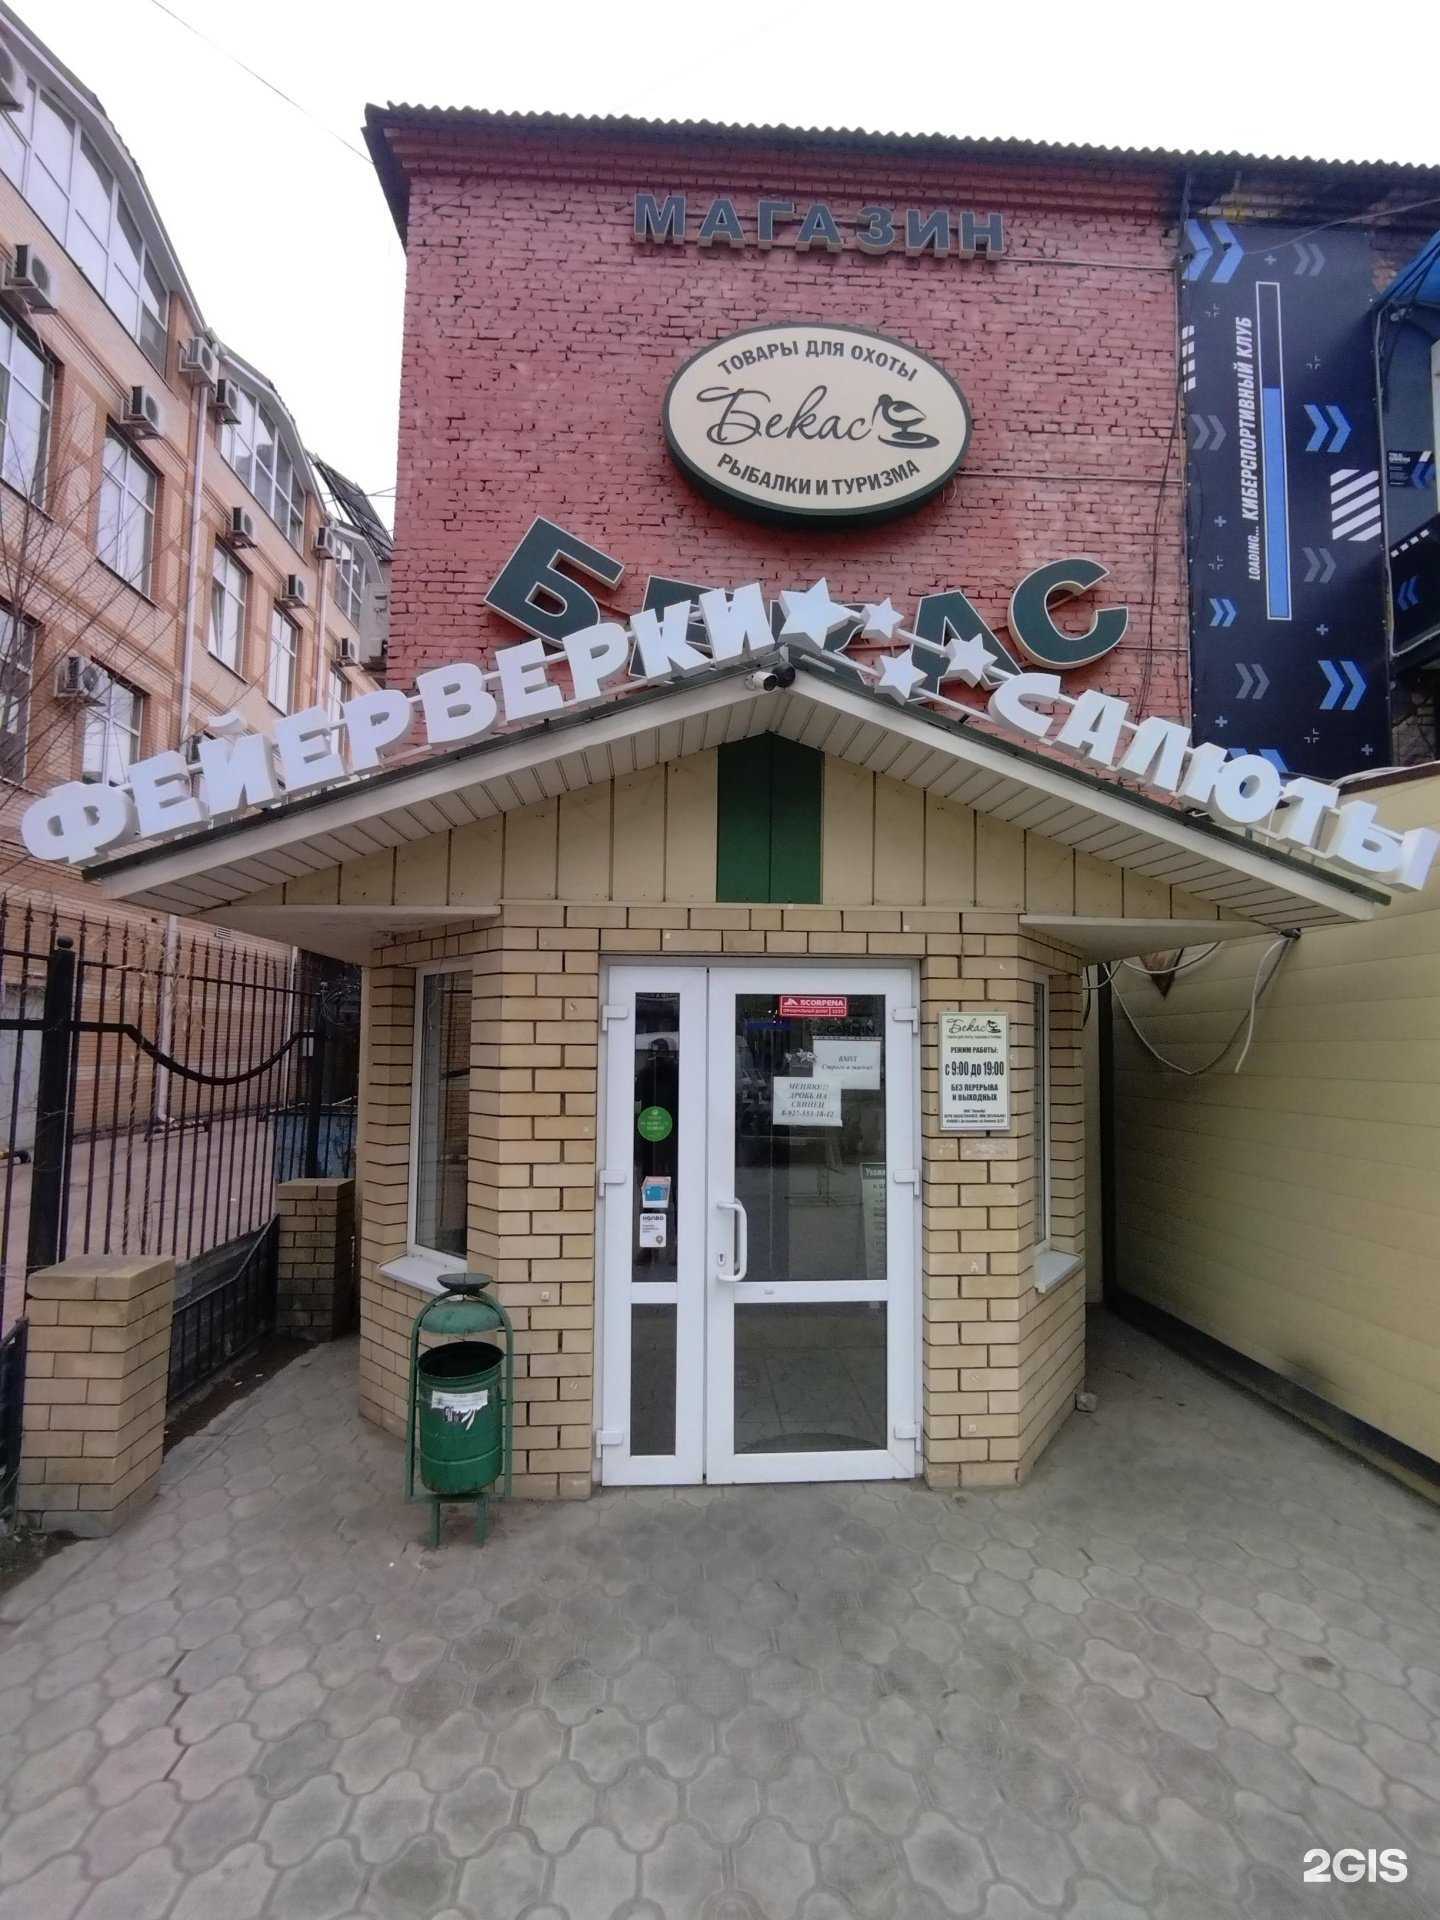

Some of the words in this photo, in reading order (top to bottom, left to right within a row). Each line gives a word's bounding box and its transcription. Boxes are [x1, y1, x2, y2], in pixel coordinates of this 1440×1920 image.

[634, 193, 1004, 258] МАГАЗИН
[1235, 316, 1253, 358] КЛУБ
[717, 340, 799, 376] ТОВАРЫ
[805, 339, 845, 358] ДЛЯ
[850, 345, 919, 382] ОХОТЫ
[696, 385, 873, 446] Бекас
[1233, 361, 1259, 521] КИБЕРСПОРТИВНЫЙ
[716, 452, 811, 495] РЫБАЛКИ
[814, 480, 829, 495] И
[831, 459, 920, 495] ТУРИЗМА
[20, 582, 776, 865] ФЕЙЕРВЕРКИ
[989, 672, 1440, 892] САЛЮТЫ
[950, 1046, 971, 1054] РЕЖИМ
[952, 1061, 969, 1076] 9:00
[971, 1063, 982, 1077] до
[984, 1061, 1004, 1076] 19:00
[951, 1084, 962, 1092] БЕЗ
[964, 1084, 998, 1092] ПЕРЕРЫВА
[958, 1094, 998, 1102] ВЫХОДНЫХ
